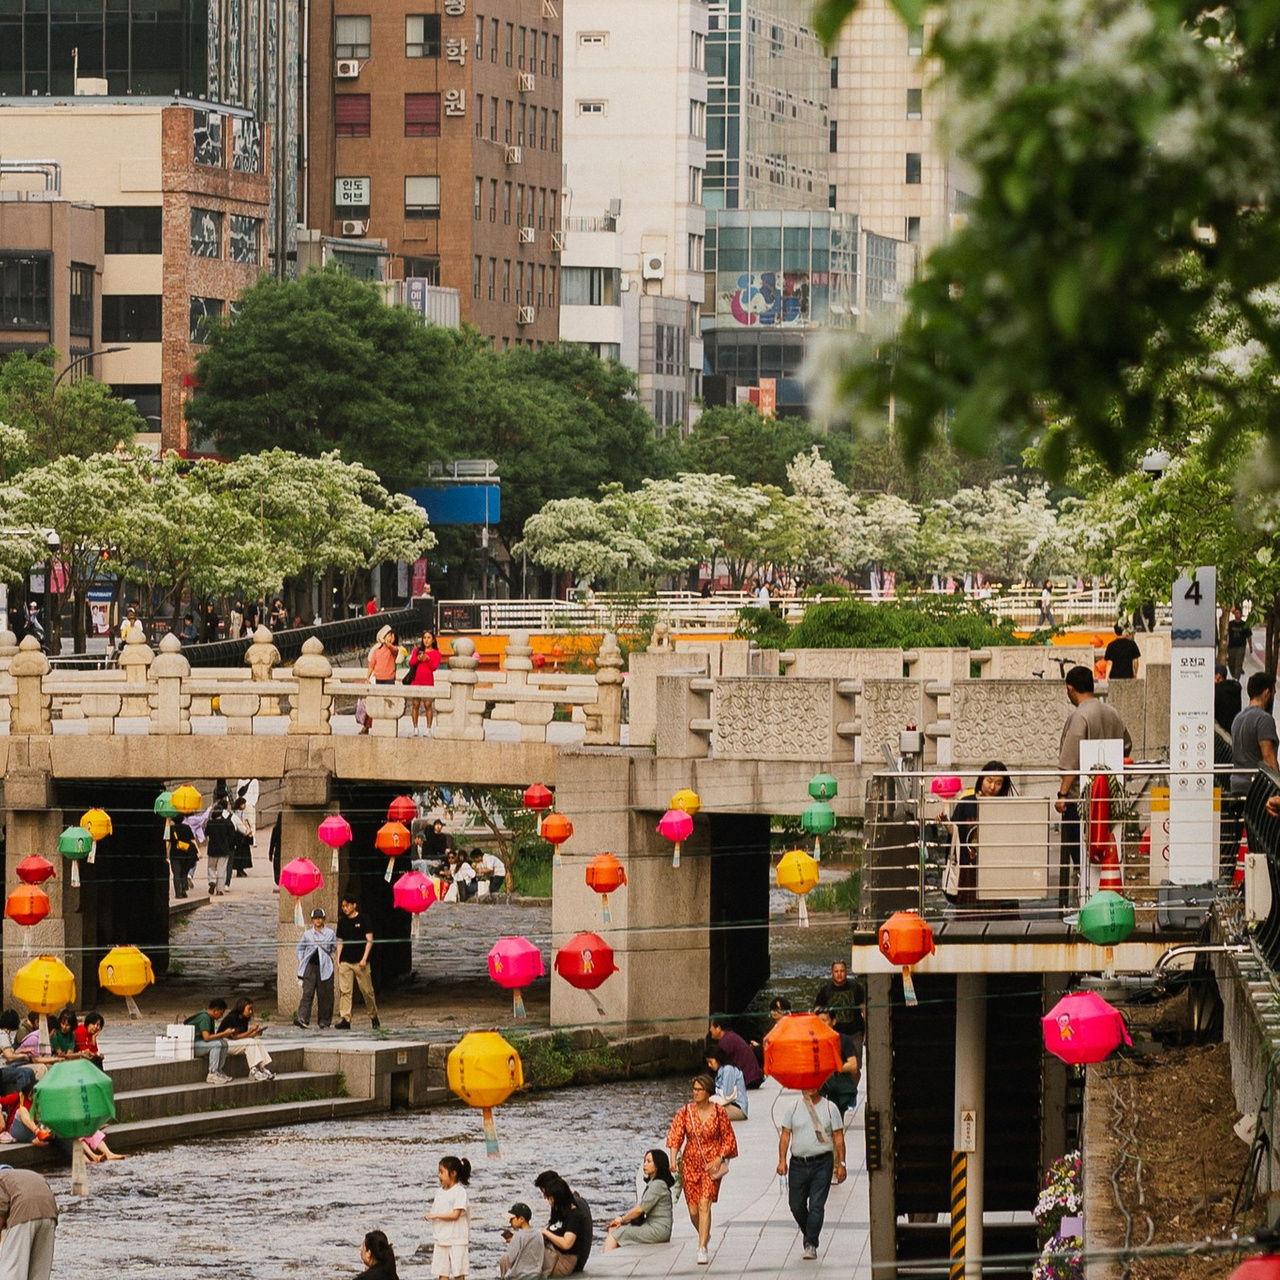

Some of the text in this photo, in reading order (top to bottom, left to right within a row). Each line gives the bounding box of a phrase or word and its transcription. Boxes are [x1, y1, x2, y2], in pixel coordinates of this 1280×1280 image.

[342, 179, 363, 191] 인도
[1184, 580, 1203, 606] 4
[1180, 657, 1206, 667] 모전교
